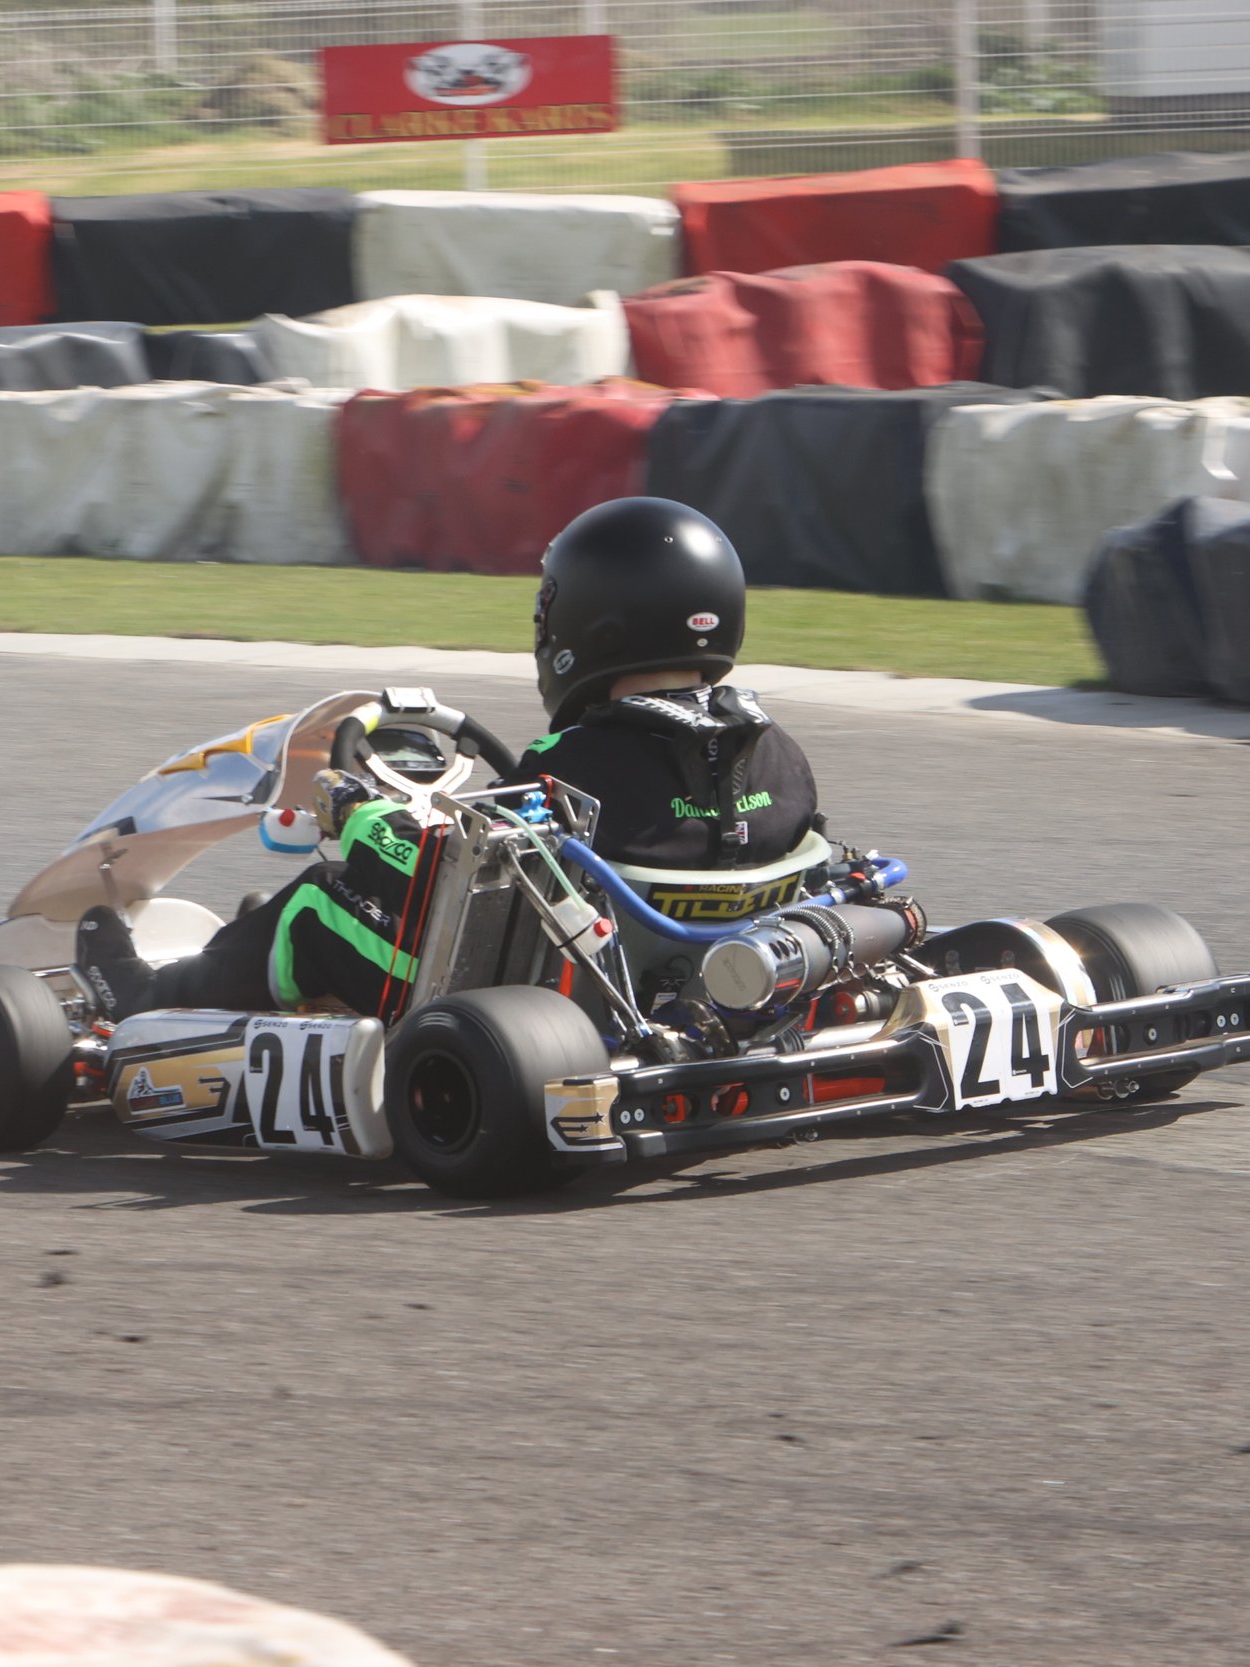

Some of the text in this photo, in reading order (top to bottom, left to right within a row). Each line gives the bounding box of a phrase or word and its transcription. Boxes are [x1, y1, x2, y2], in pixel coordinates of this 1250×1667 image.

[692, 617, 715, 626] BELL
[332, 879, 391, 927] THUNDER
[941, 983, 1050, 1099] 24
[249, 1032, 335, 1146] 24
